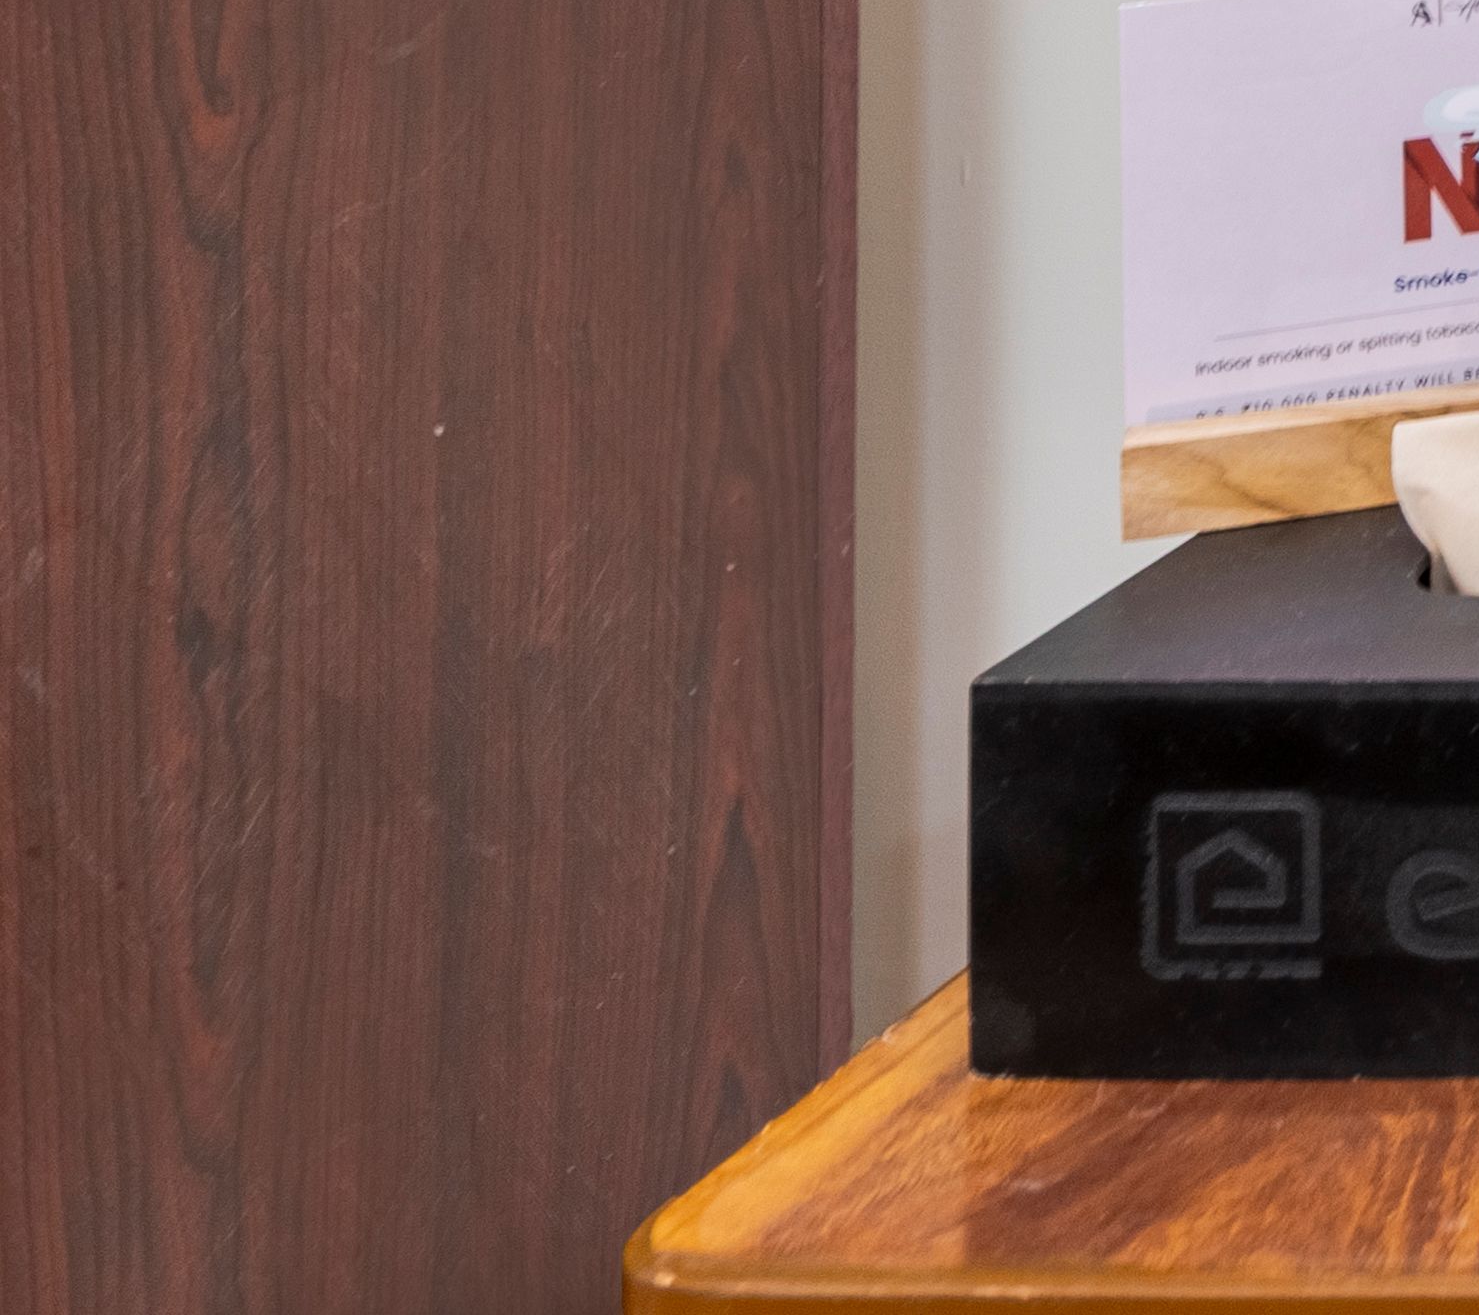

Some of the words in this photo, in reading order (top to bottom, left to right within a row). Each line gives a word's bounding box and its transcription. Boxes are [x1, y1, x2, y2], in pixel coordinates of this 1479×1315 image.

[1195, 355, 1252, 377] Indoor
[1257, 343, 1332, 368] smoking
[1336, 341, 1353, 355] or
[1358, 329, 1422, 355] spitting
[1325, 377, 1406, 402] PENALTY
[1414, 371, 1453, 390] WILL
